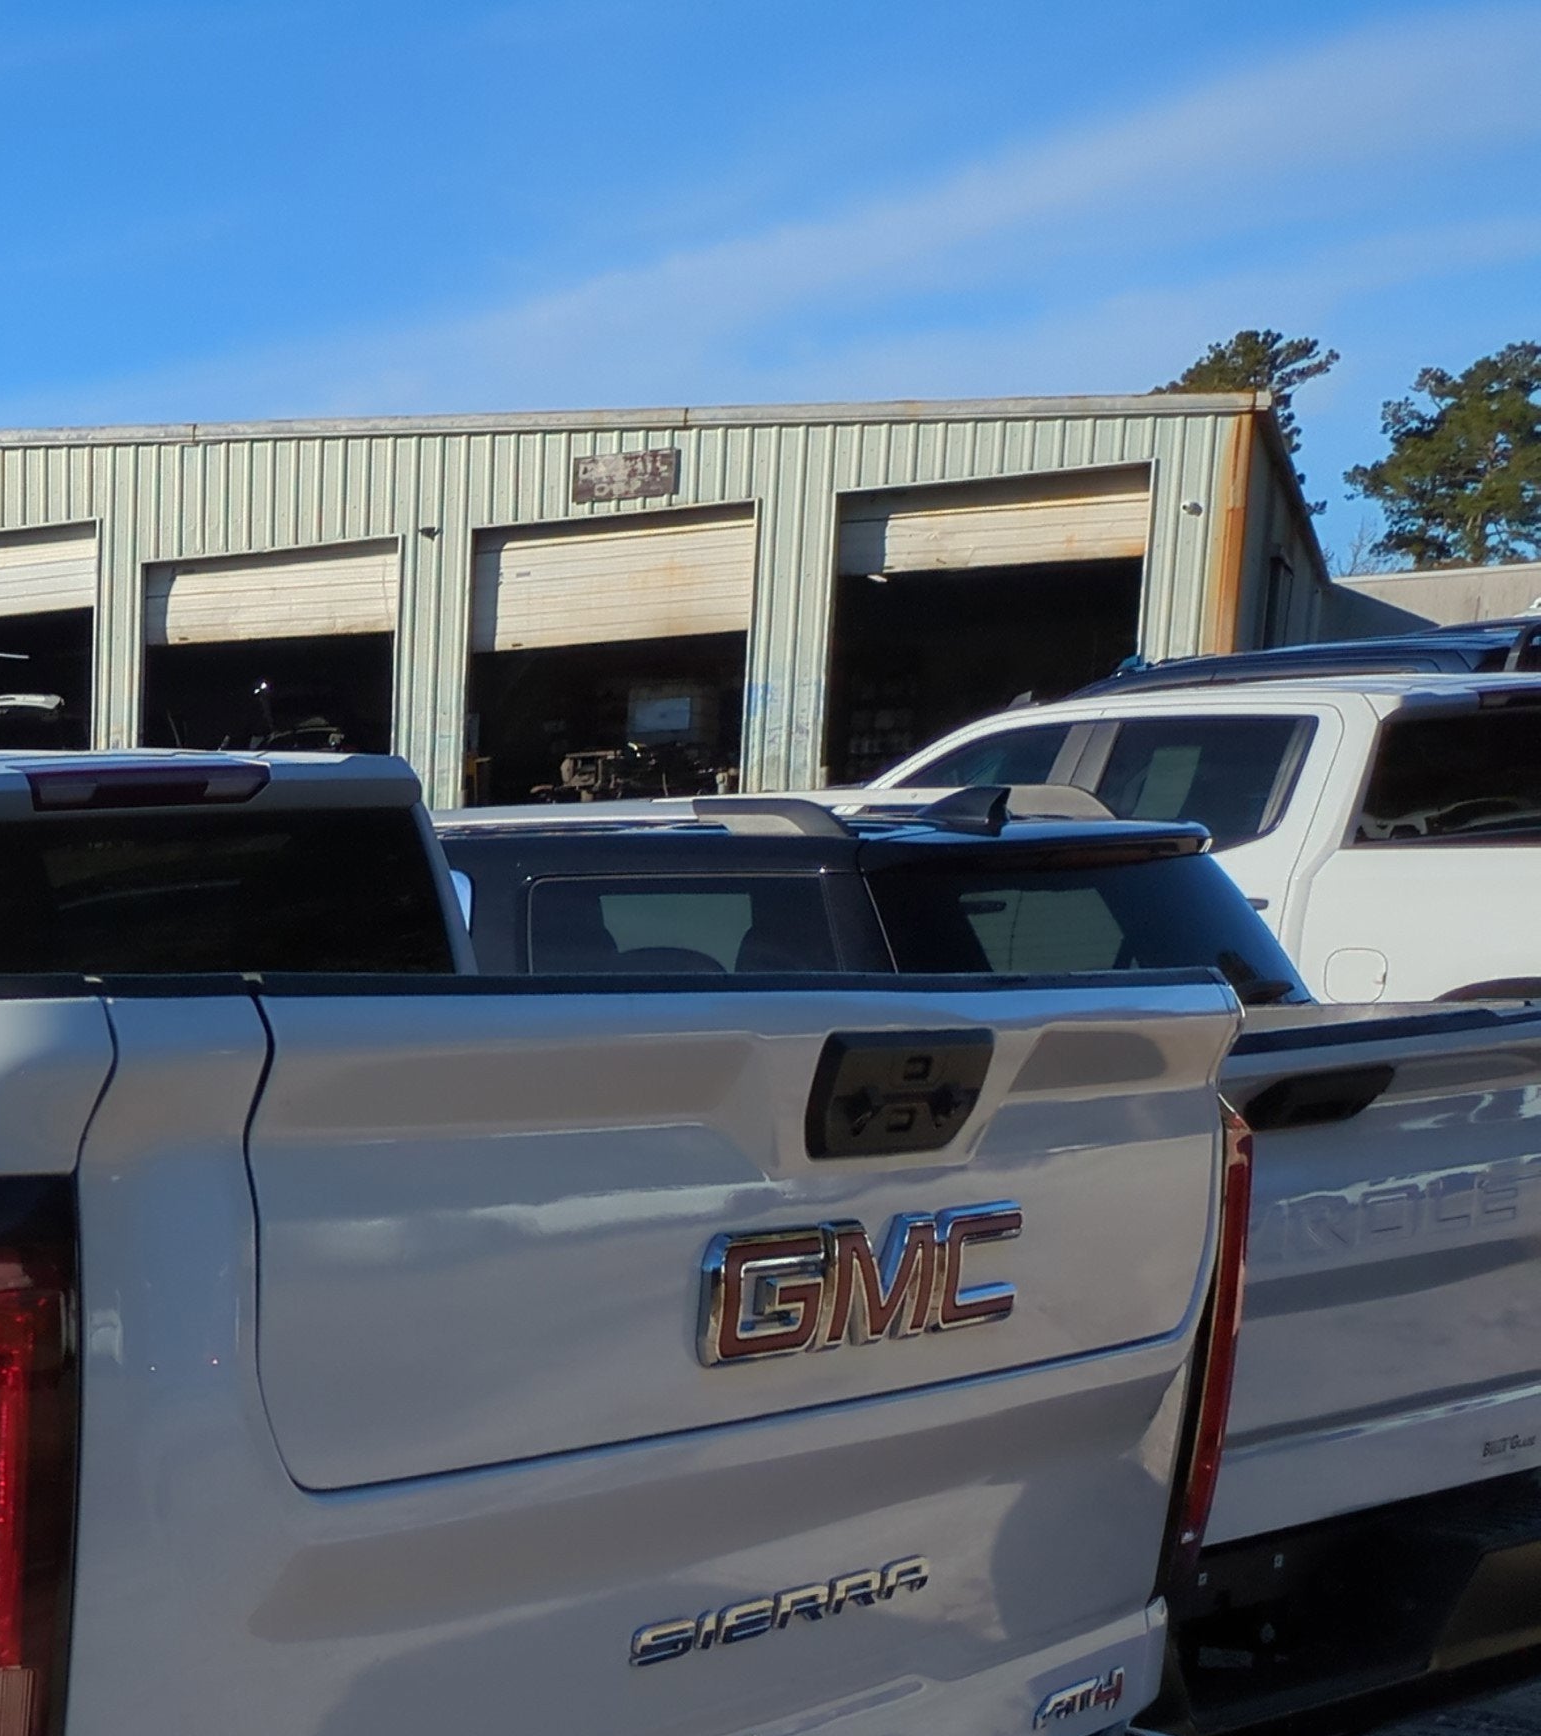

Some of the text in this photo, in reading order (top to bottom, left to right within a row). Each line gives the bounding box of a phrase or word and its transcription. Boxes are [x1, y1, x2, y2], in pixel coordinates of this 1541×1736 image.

[697, 1199, 1022, 1367] GMC
[629, 1553, 931, 1668] SIERRA
[1033, 1666, 1125, 1730] AT4
